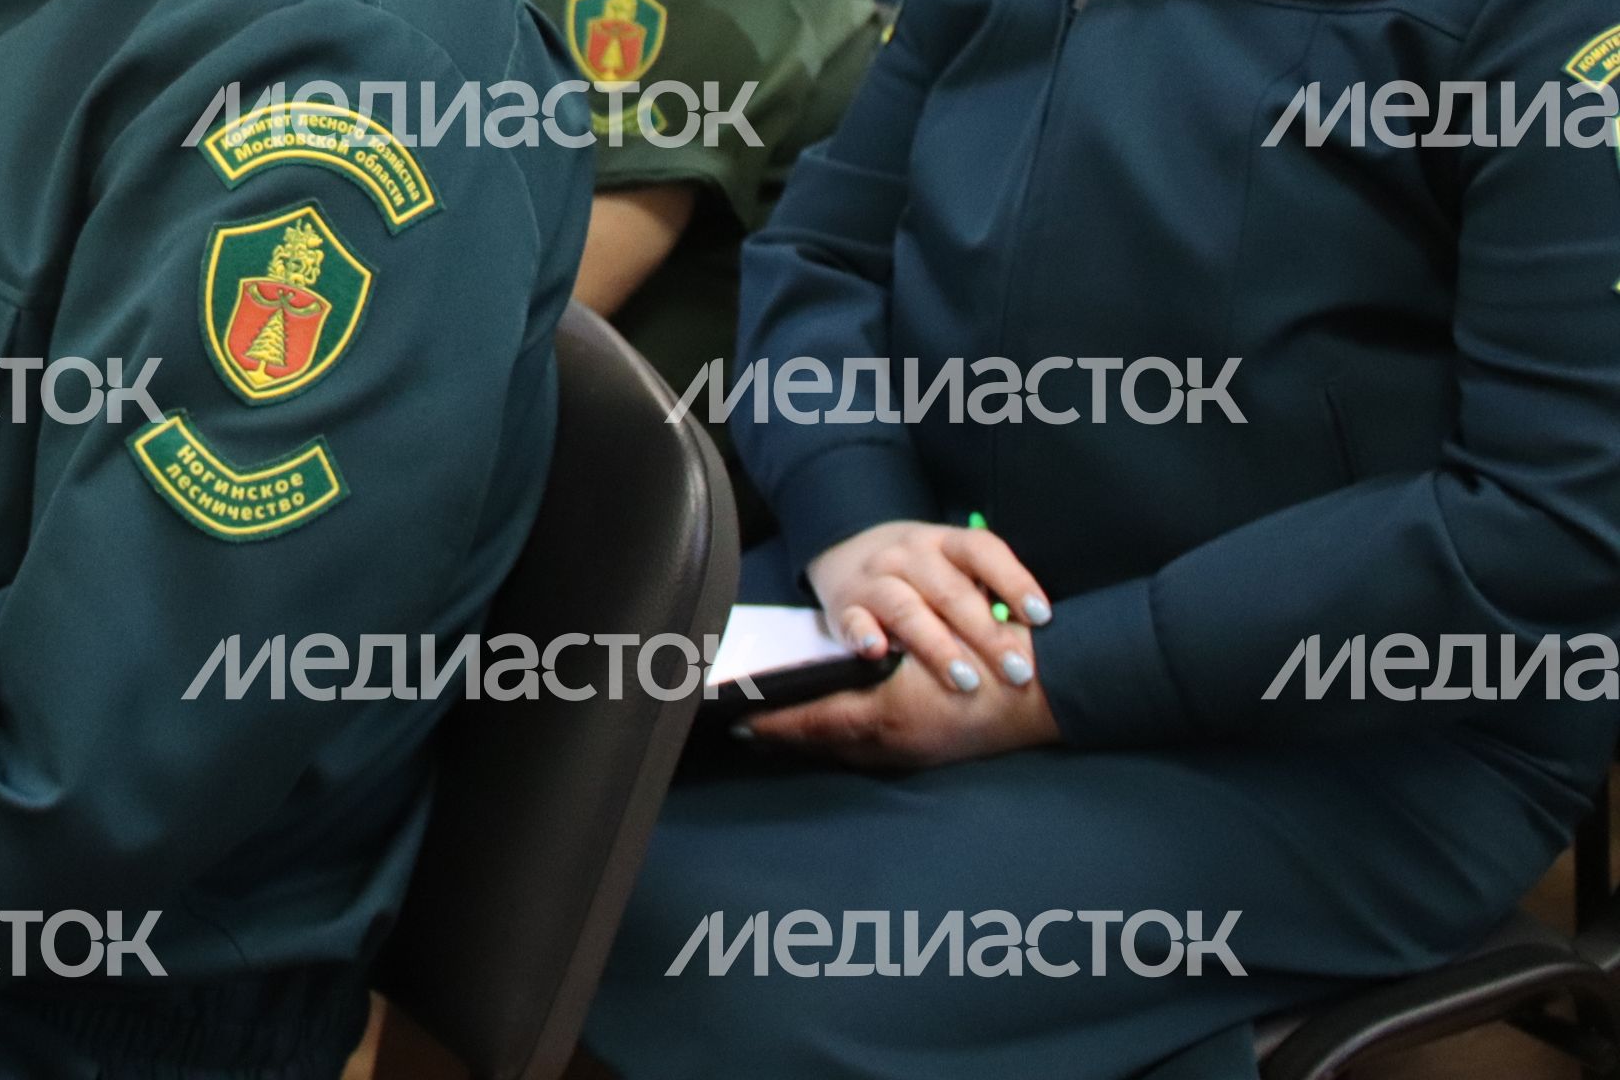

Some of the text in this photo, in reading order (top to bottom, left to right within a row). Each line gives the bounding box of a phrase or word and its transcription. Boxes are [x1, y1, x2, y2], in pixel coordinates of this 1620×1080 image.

[221, 113, 420, 202] Комитет лесного хозяйства
[234, 131, 406, 207] Московской области
[166, 462, 305, 521] лесничество
[176, 443, 304, 501] Ногинское
